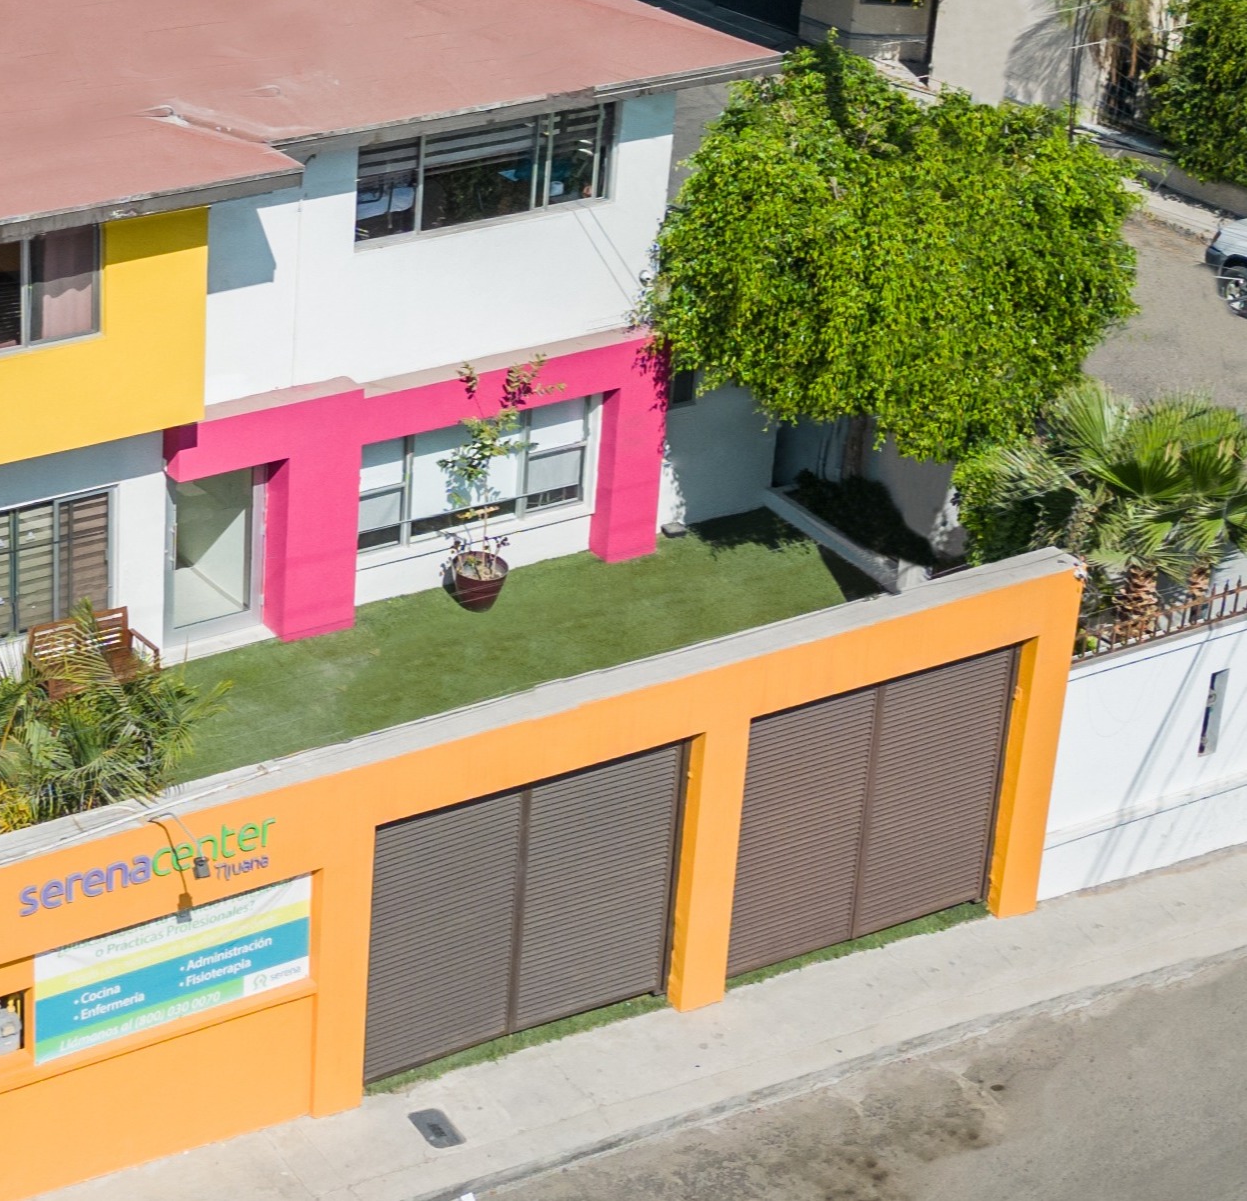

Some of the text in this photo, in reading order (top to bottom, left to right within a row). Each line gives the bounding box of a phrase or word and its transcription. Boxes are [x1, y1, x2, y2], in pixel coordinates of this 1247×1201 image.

[214, 854, 269, 881] Tijuana
[186, 937, 273, 971] Administración
[185, 958, 252, 987] Fisioterapia
[80, 984, 121, 1004] Cocina
[80, 992, 145, 1020] Enfermería
[191, 990, 221, 1009] 0070
